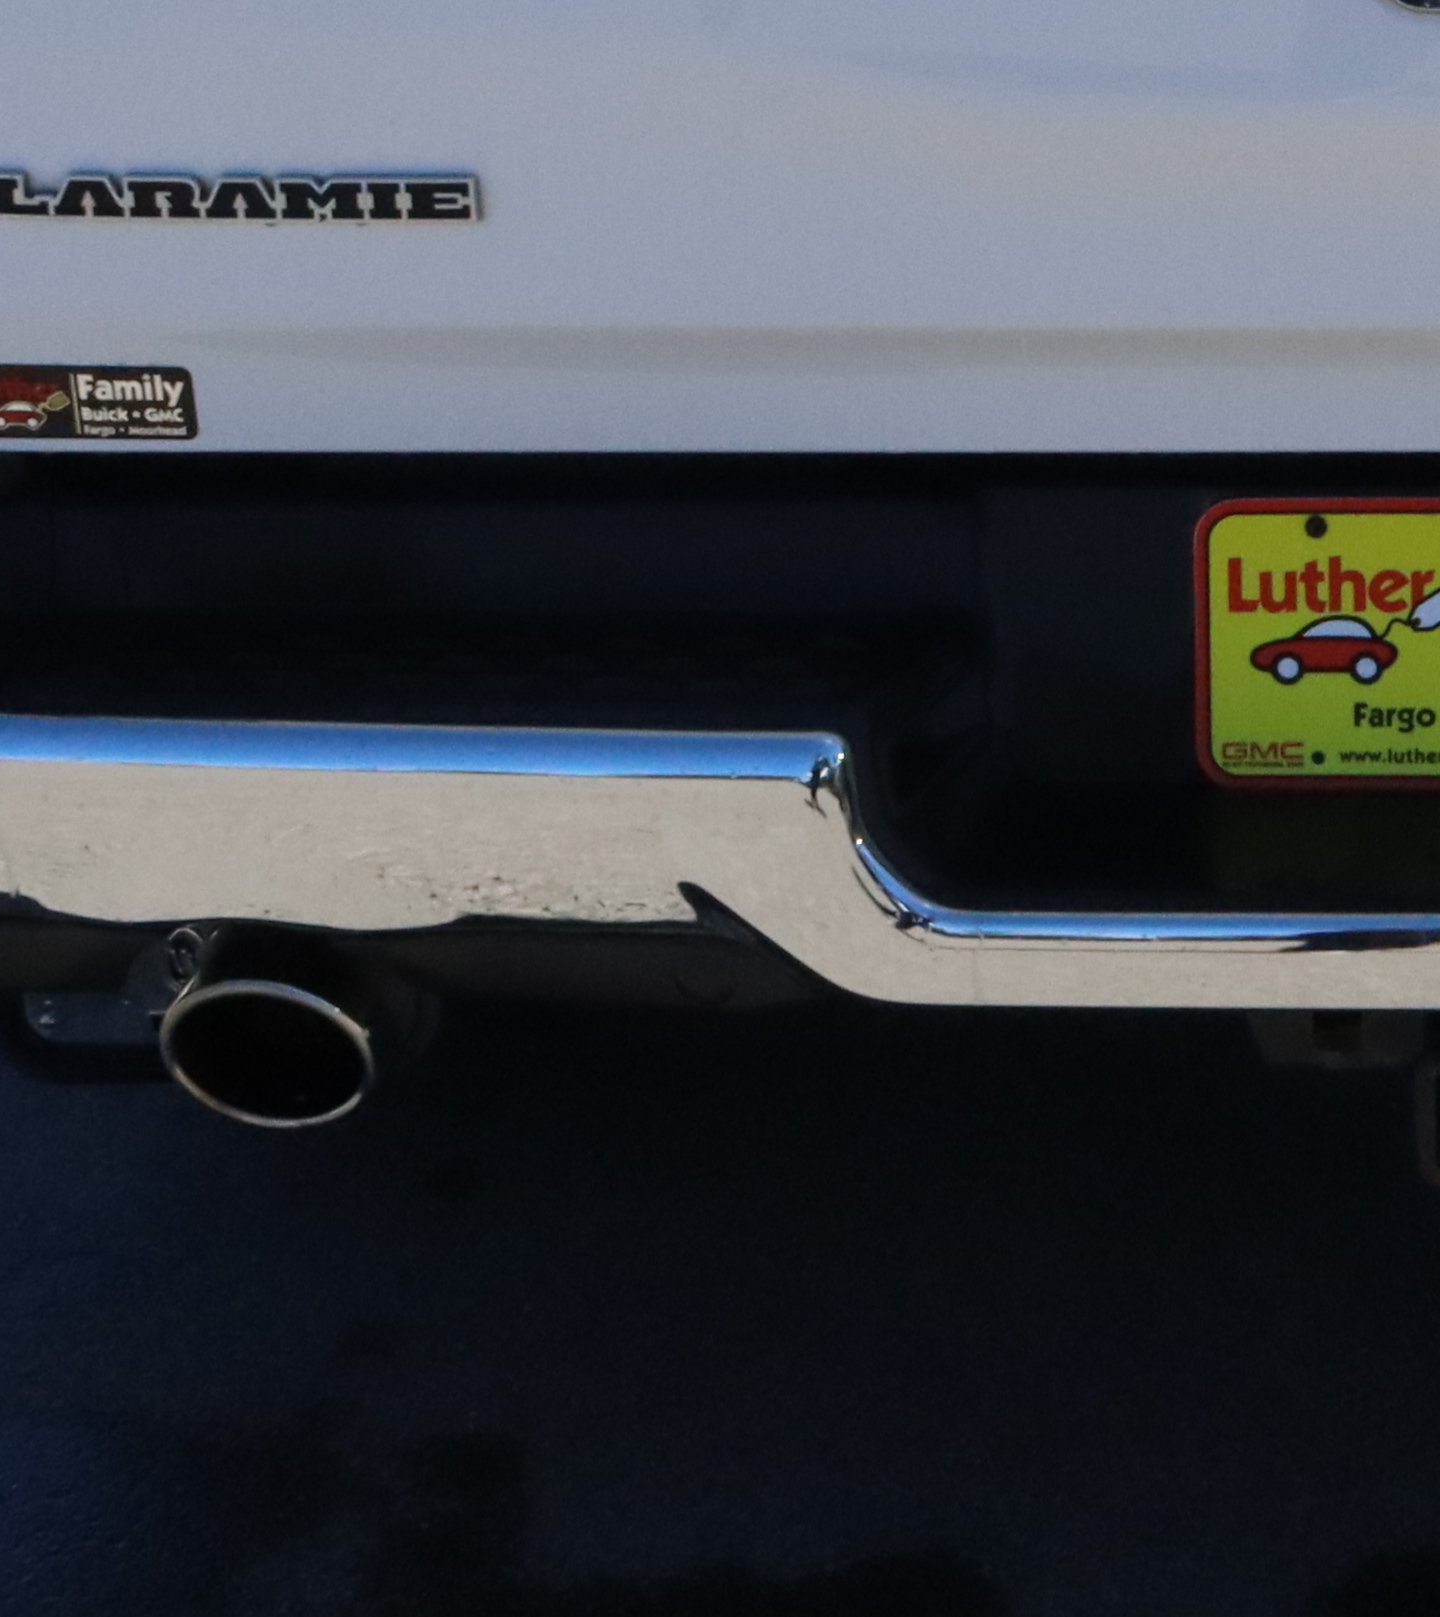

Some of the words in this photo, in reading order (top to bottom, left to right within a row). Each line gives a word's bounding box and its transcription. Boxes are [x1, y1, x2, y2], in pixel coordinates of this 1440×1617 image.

[75, 373, 185, 408] Family
[80, 407, 129, 423] Buick
[144, 408, 184, 423] GMC
[1227, 555, 1435, 614] Luther
[1353, 702, 1437, 732] Fargo
[1221, 741, 1304, 761] GMC
